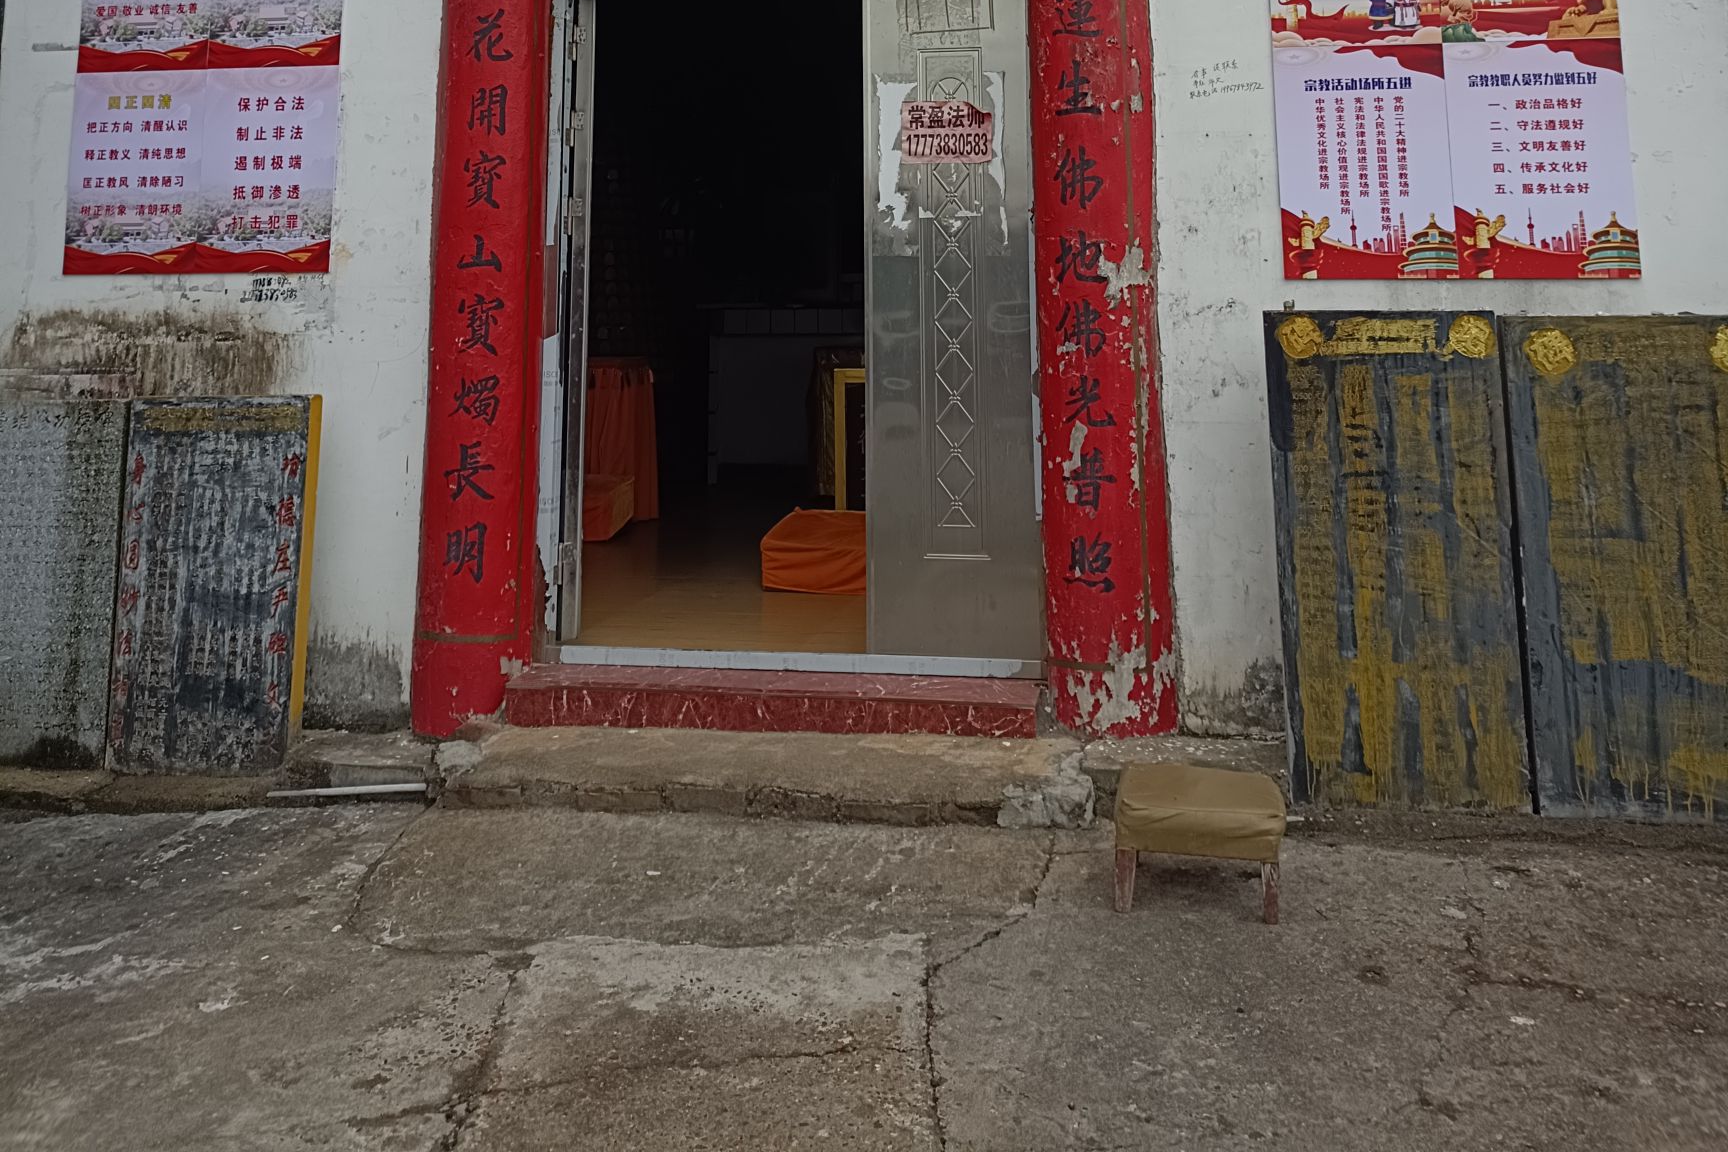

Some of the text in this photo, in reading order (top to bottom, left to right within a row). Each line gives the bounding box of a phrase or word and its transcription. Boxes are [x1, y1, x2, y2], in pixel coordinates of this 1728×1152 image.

[1304, 77, 1412, 91] 宗教活动场所五进
[1468, 72, 1597, 87] 宗教教职人员努力做到五好
[238, 96, 305, 112] 保护合法
[908, 105, 985, 129] 常盈法师
[87, 120, 188, 134] 把正方向 清醒认识
[236, 126, 303, 141] 制止非法
[906, 133, 988, 156] 17773830583
[1315, 98, 1329, 189] 中华优秀文化进宗教场所
[1354, 97, 1369, 197] 宪法和法律法规进宗教场所
[1393, 96, 1409, 197] 党的二十大精神进宗教场所
[139, 148, 186, 160] 清纯思想
[1335, 98, 1350, 214] 社会主义核心价值观进宗教场所
[234, 155, 302, 171] 遏制极端
[1374, 96, 1391, 231] 中华人民共和国国旗国歌进宗教场所
[137, 176, 184, 188] 清除陋习
[233, 185, 301, 200] 抵御渗透
[231, 215, 299, 230] 打击犯罪
